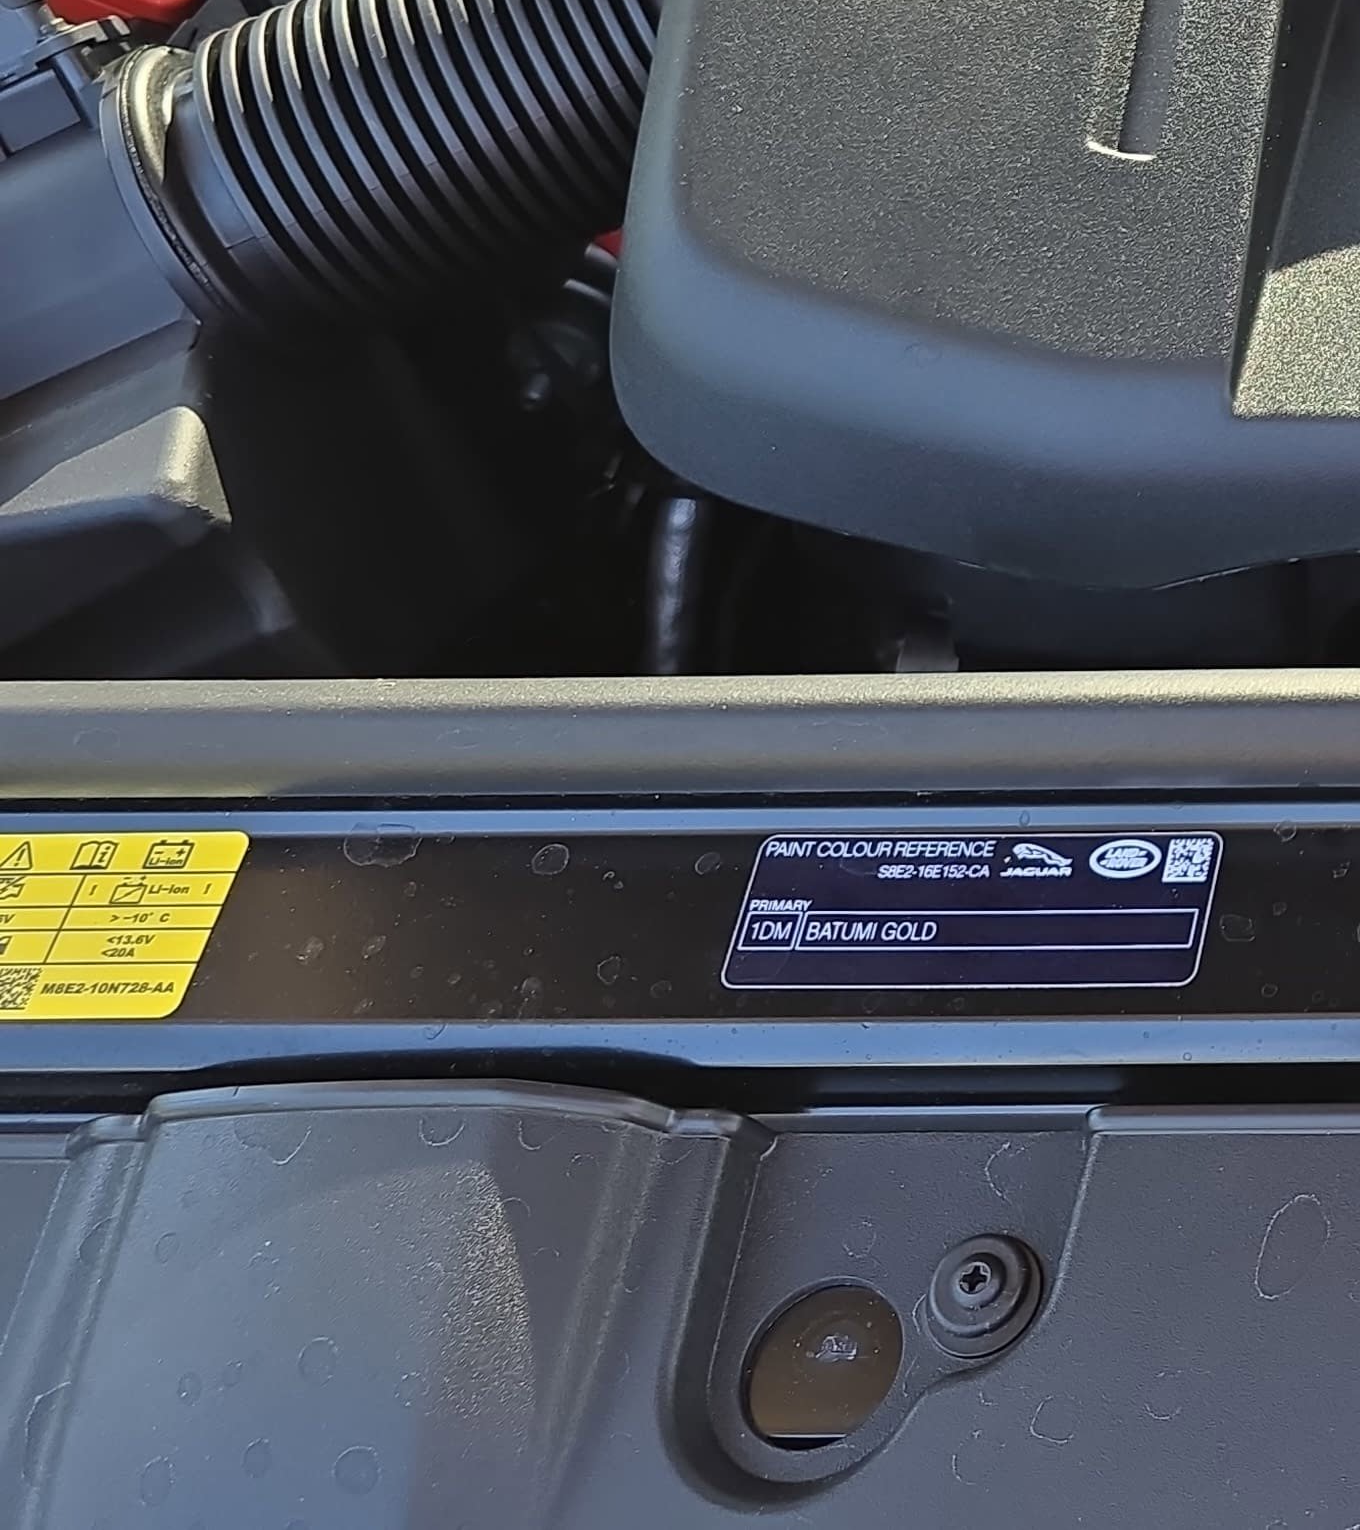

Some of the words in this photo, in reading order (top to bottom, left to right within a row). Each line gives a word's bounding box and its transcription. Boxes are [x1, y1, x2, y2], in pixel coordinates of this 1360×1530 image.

[765, 841, 816, 858] PAINT
[816, 841, 892, 858] COLOUR
[892, 840, 995, 858] REFERENCE
[1000, 866, 1073, 878] JAGUAR
[749, 899, 812, 912] PRIMARY
[750, 922, 793, 940] 1DM
[805, 923, 878, 941] BATUMI
[881, 922, 937, 940] GOLD
